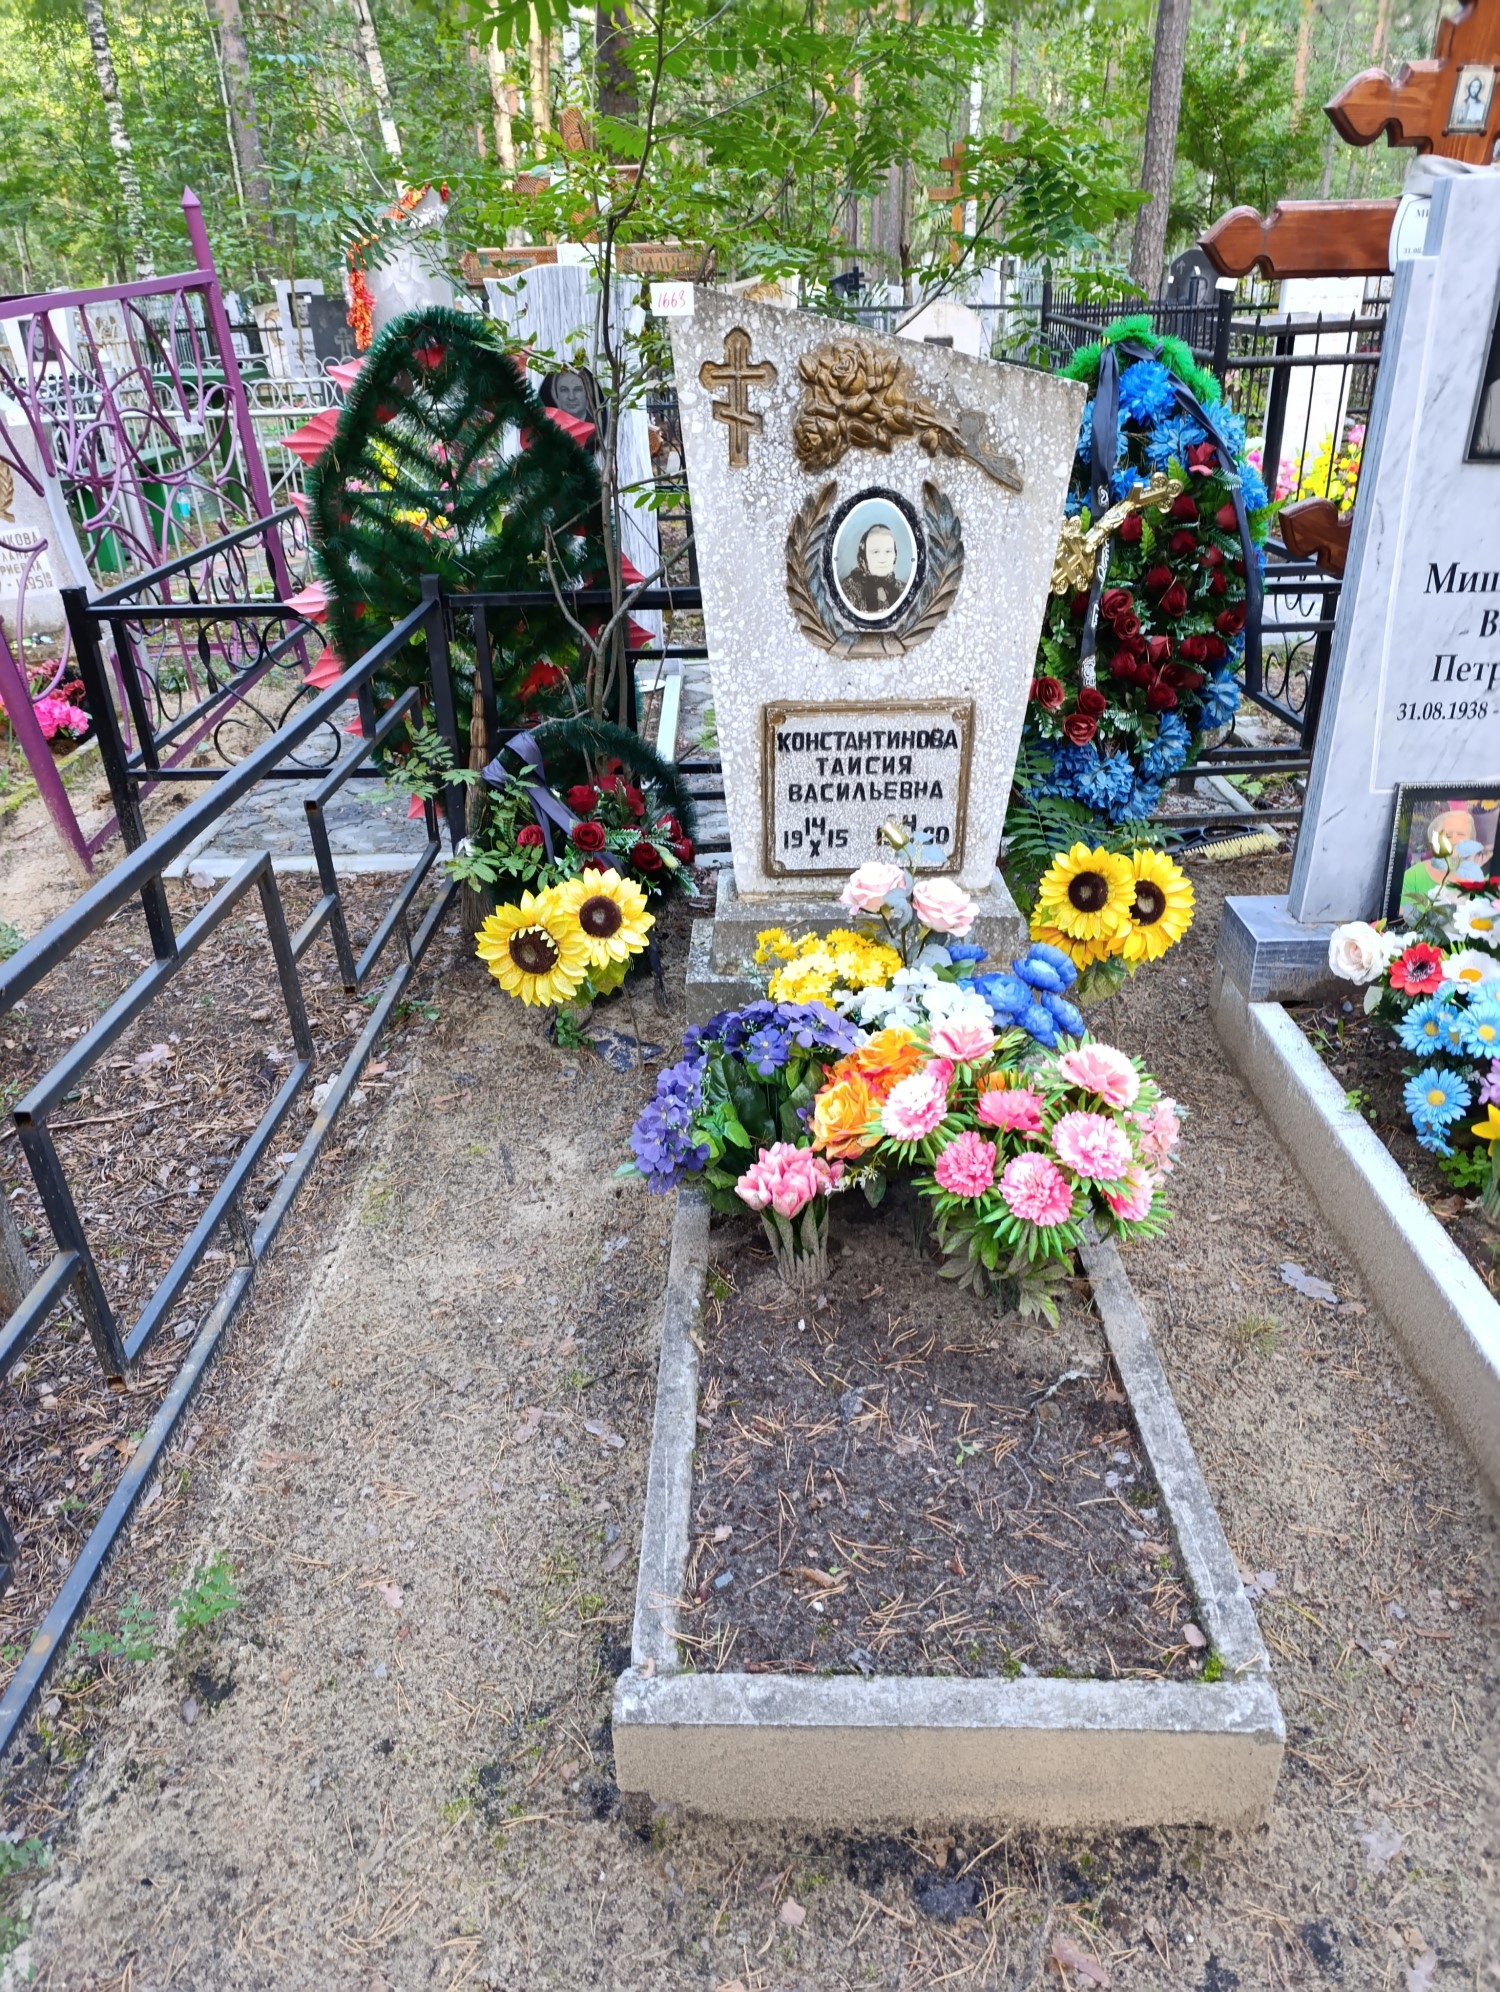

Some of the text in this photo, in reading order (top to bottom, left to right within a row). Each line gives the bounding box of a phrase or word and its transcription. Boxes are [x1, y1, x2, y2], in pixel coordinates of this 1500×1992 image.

[1479, 609, 1500, 637] В
[1396, 701, 1489, 721] 31.08.1938
[777, 729, 958, 752] КОНСТАНТИНОВА
[816, 756, 912, 776] ТАИСИЯ
[788, 780, 943, 803] ВАСИЛЬЕВНА
[804, 817, 826, 836] 14
